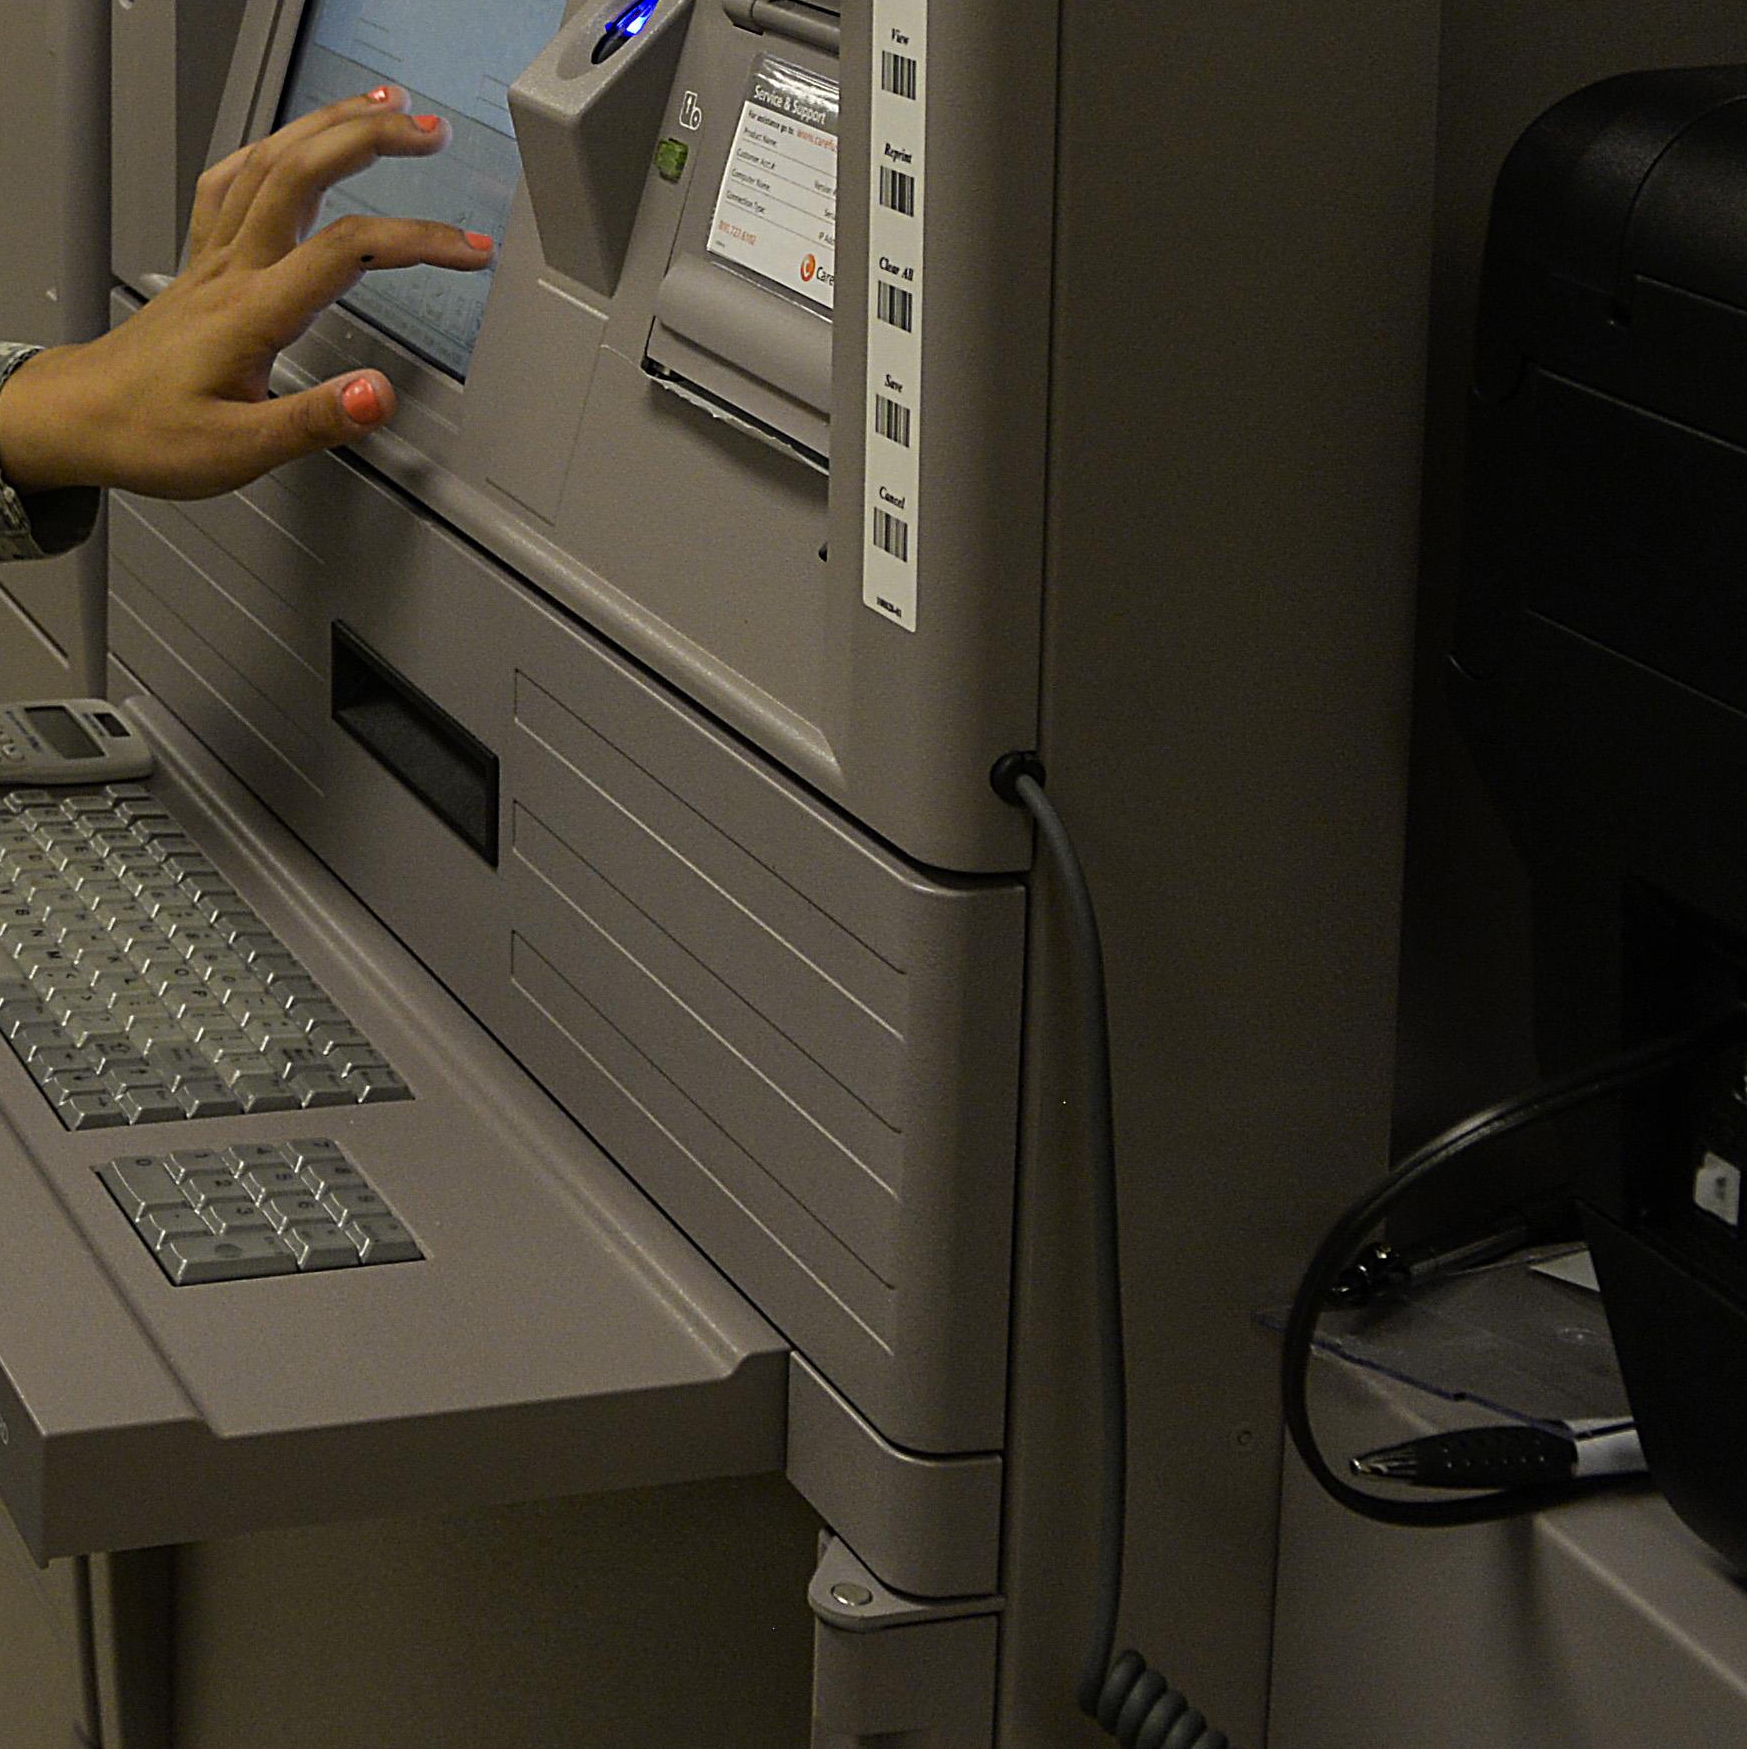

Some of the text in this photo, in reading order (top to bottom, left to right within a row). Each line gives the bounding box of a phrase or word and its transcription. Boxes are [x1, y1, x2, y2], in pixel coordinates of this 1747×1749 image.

[891, 27, 910, 47] View
[753, 84, 827, 125] Service & Support
[884, 142, 914, 165] Reprint
[879, 255, 915, 283] Clear All
[884, 373, 904, 394] Save
[879, 485, 906, 511] Cancel
